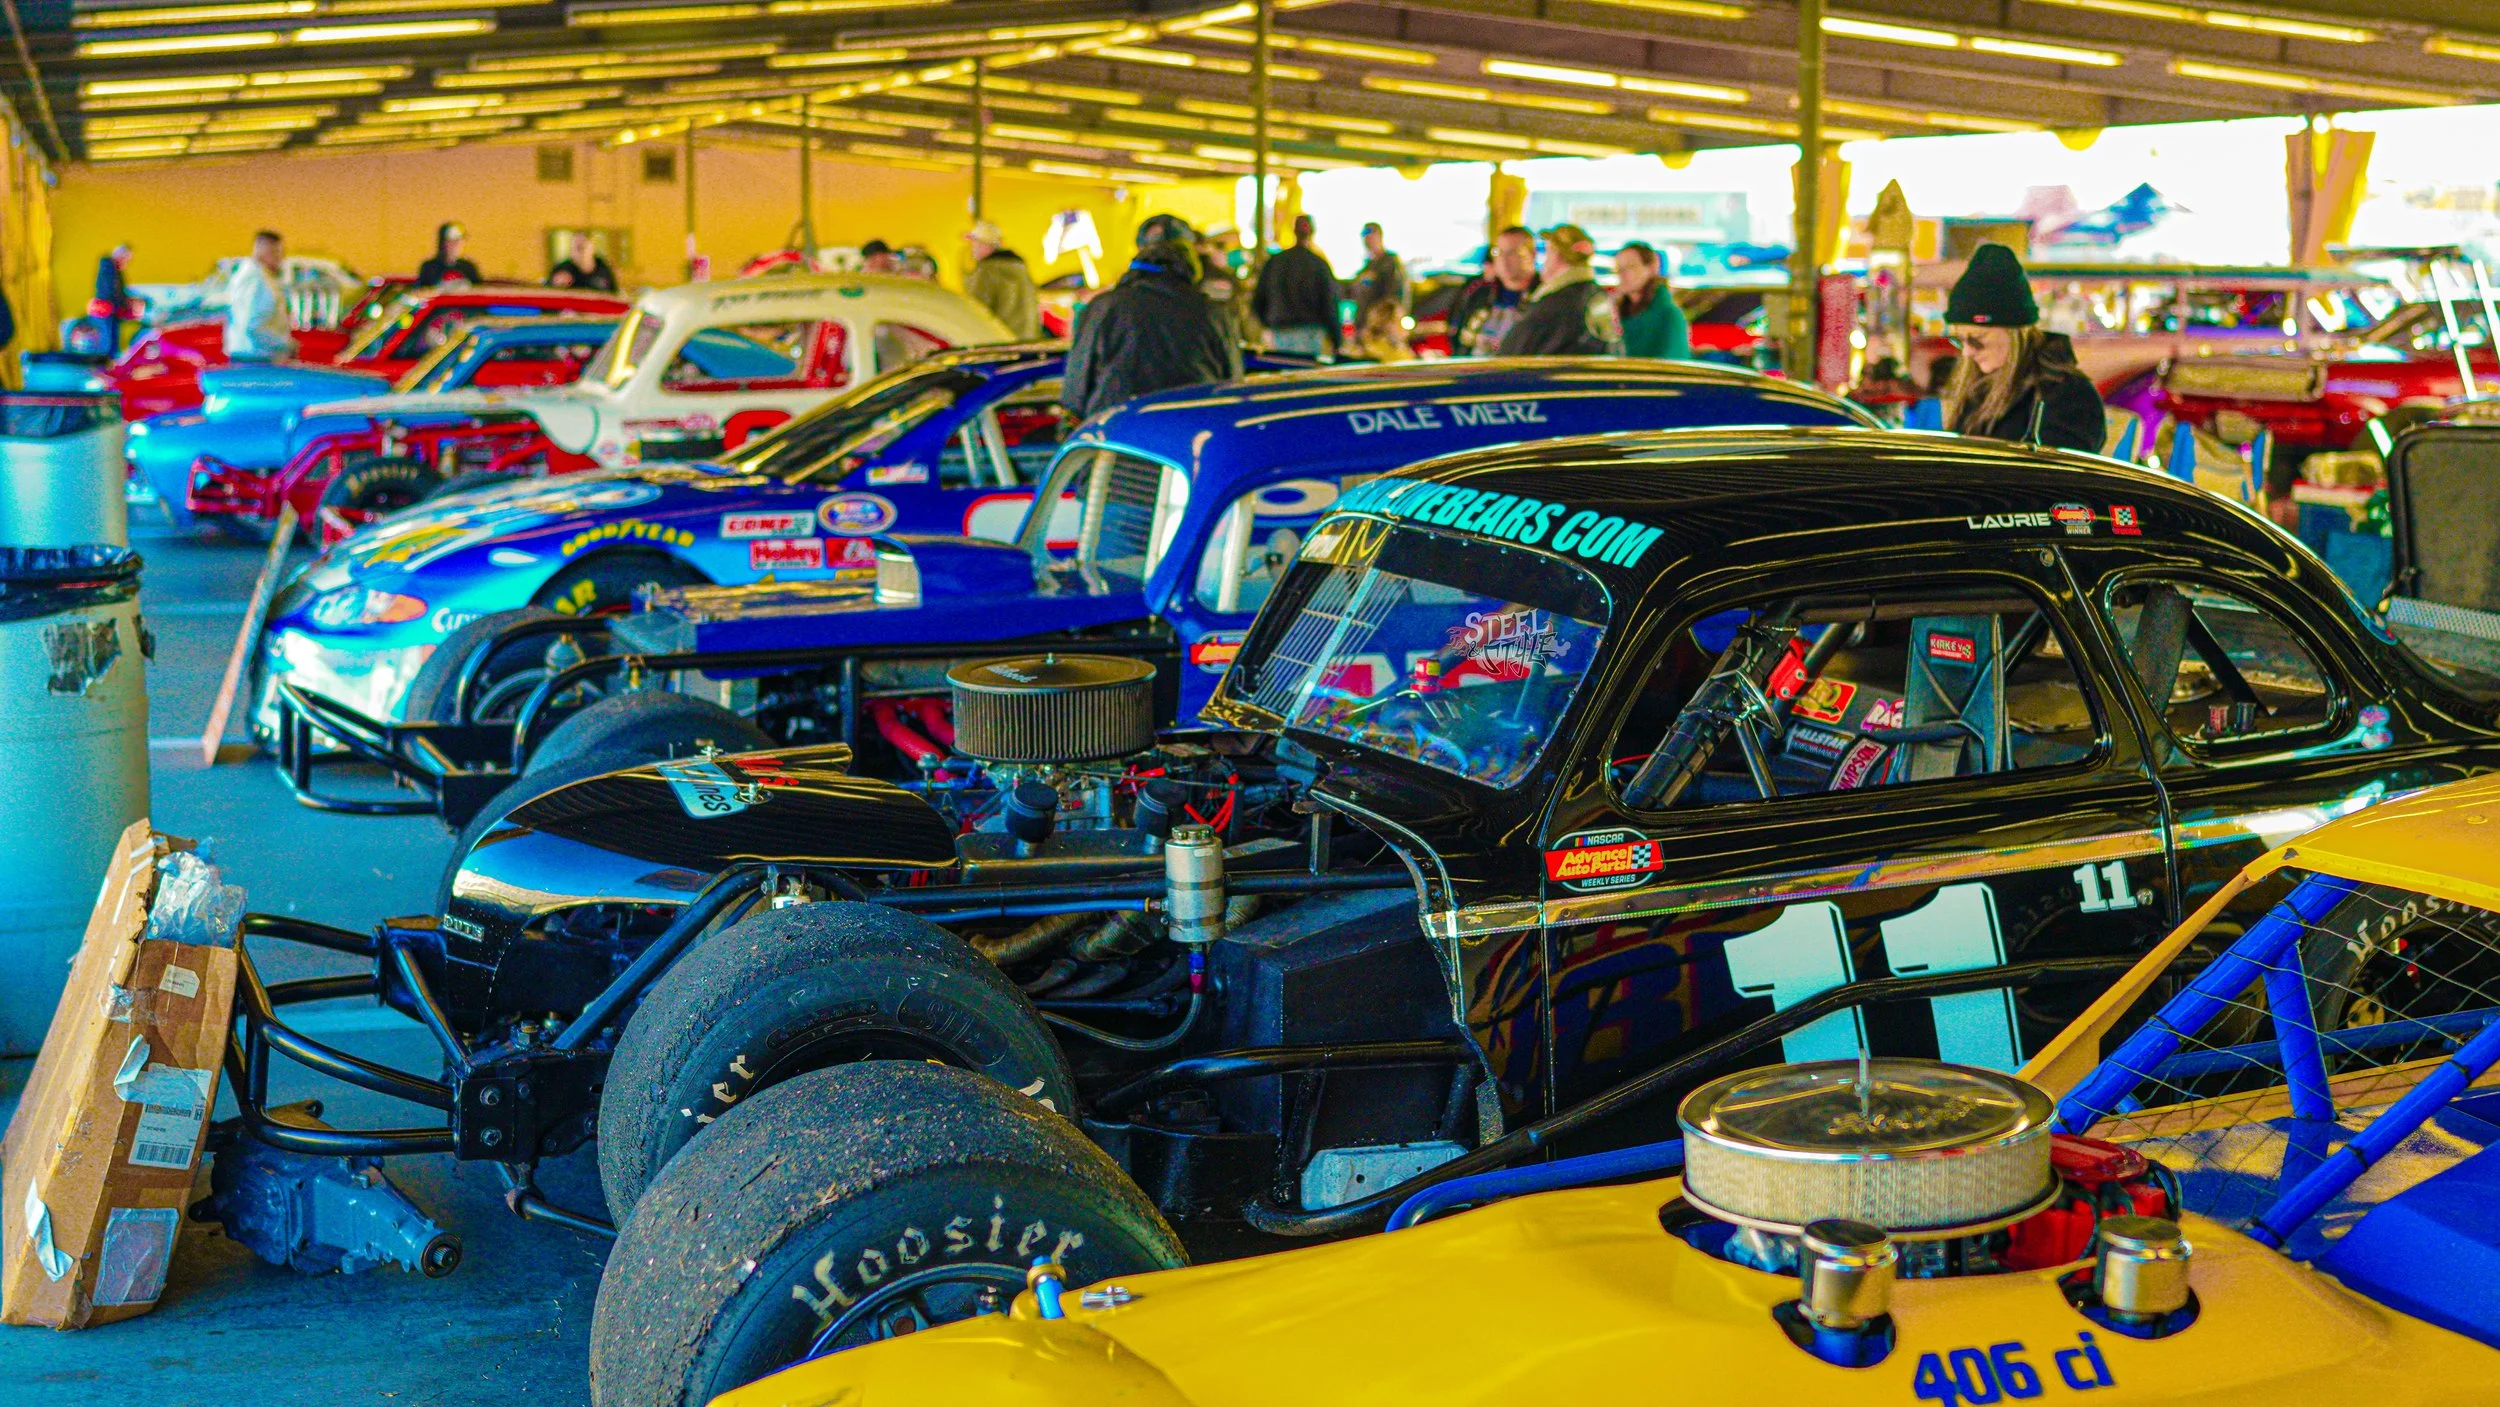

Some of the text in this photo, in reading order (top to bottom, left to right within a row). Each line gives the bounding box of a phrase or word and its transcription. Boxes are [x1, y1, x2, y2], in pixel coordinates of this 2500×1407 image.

[1348, 401, 1547, 435] DALE MERZ
[1967, 512, 2051, 530] LAURIE
[1464, 607, 1550, 645] STEEL
[1467, 632, 1557, 677] & STYLE
[1930, 639, 1963, 652] KIRKEY
[1795, 727, 1848, 751] ALLSTAR
[1586, 833, 1624, 846] NASCAR
[1556, 859, 1628, 877] Auto Parts
[1563, 849, 1627, 863] Advance
[1581, 874, 1636, 888] WEEKLY SERIES
[2073, 861, 2137, 912] 11
[1723, 882, 2030, 1075] 11
[792, 1194, 1084, 1338] Hoosier
[1914, 1331, 2116, 1407] 406 ci
